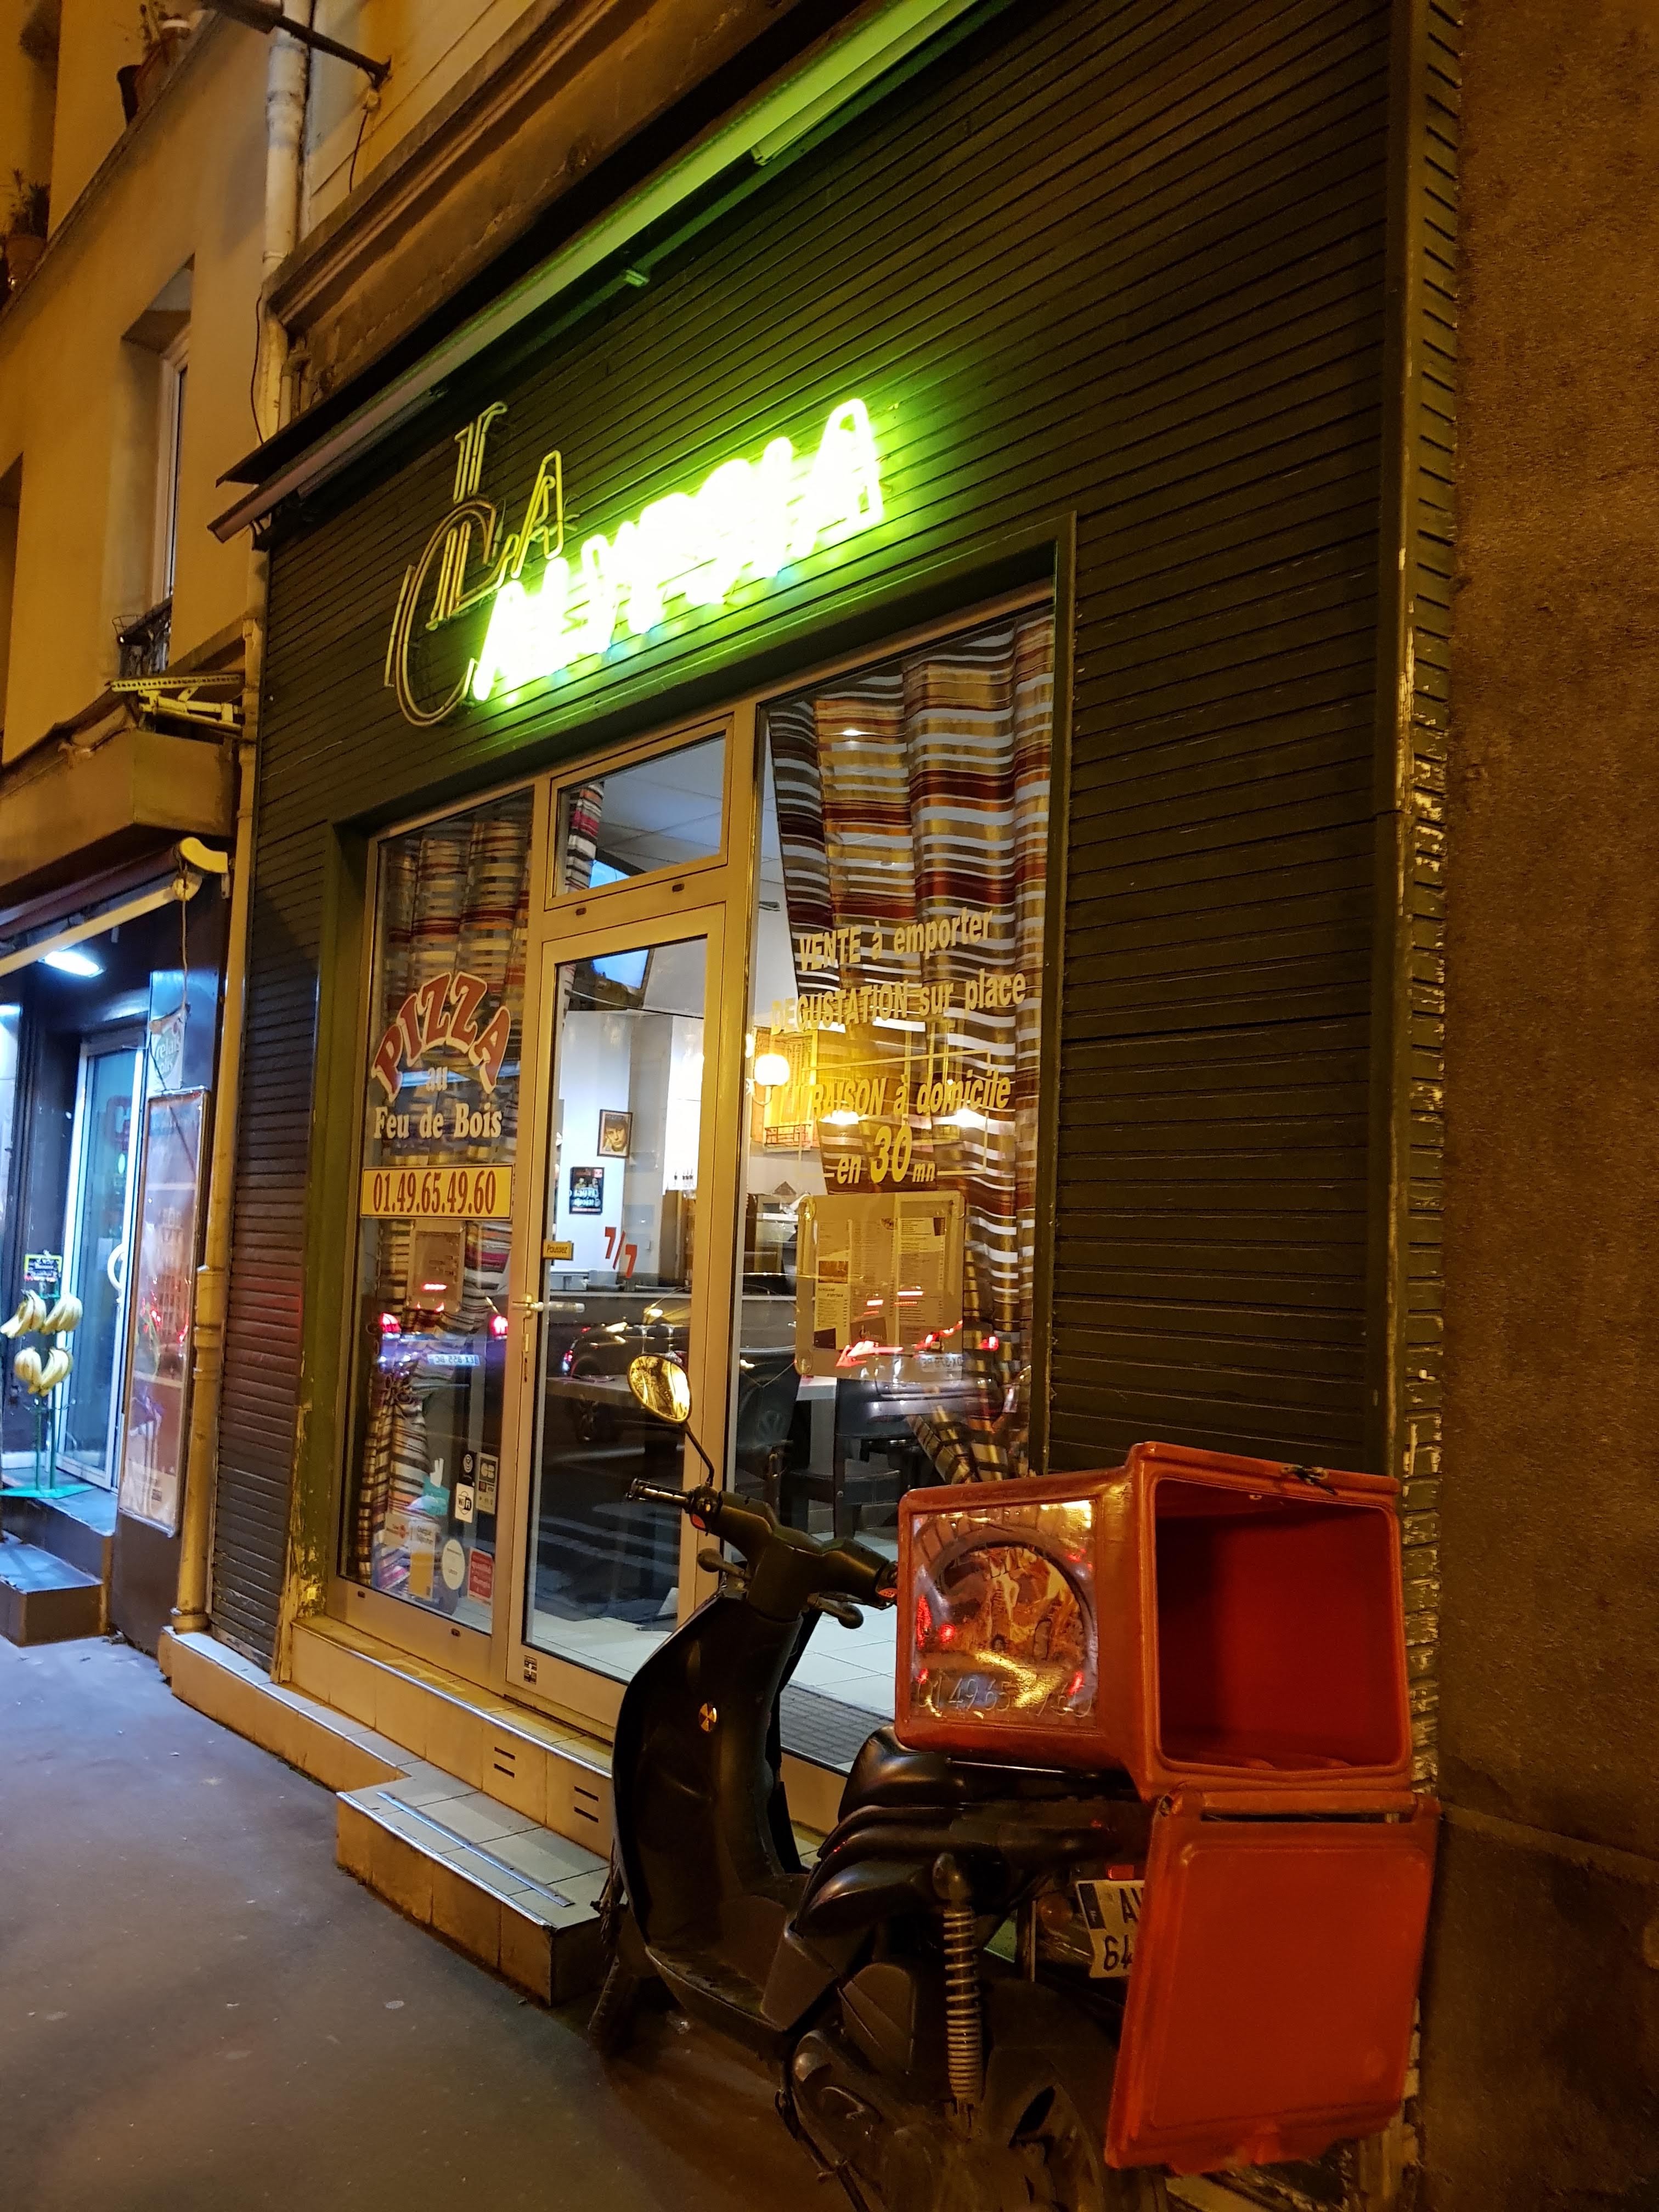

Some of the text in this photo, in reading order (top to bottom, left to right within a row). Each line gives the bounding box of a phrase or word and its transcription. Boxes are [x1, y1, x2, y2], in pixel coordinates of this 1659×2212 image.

[799, 906, 993, 972] VENTE à emporter
[919, 983, 954, 1016] sur
[965, 968, 1026, 1020] place
[373, 972, 511, 1102] PIZZA
[426, 1065, 448, 1092] au
[893, 1074, 908, 1115] à
[917, 1068, 1011, 1116] domicile
[374, 1102, 502, 1139] Feu de Bois
[837, 1125, 935, 1184] en 30 mn
[373, 1170, 497, 1214] 01.49.65.49.60
[546, 1244, 568, 1254] Poussez
[605, 1226, 637, 1279] 7/7
